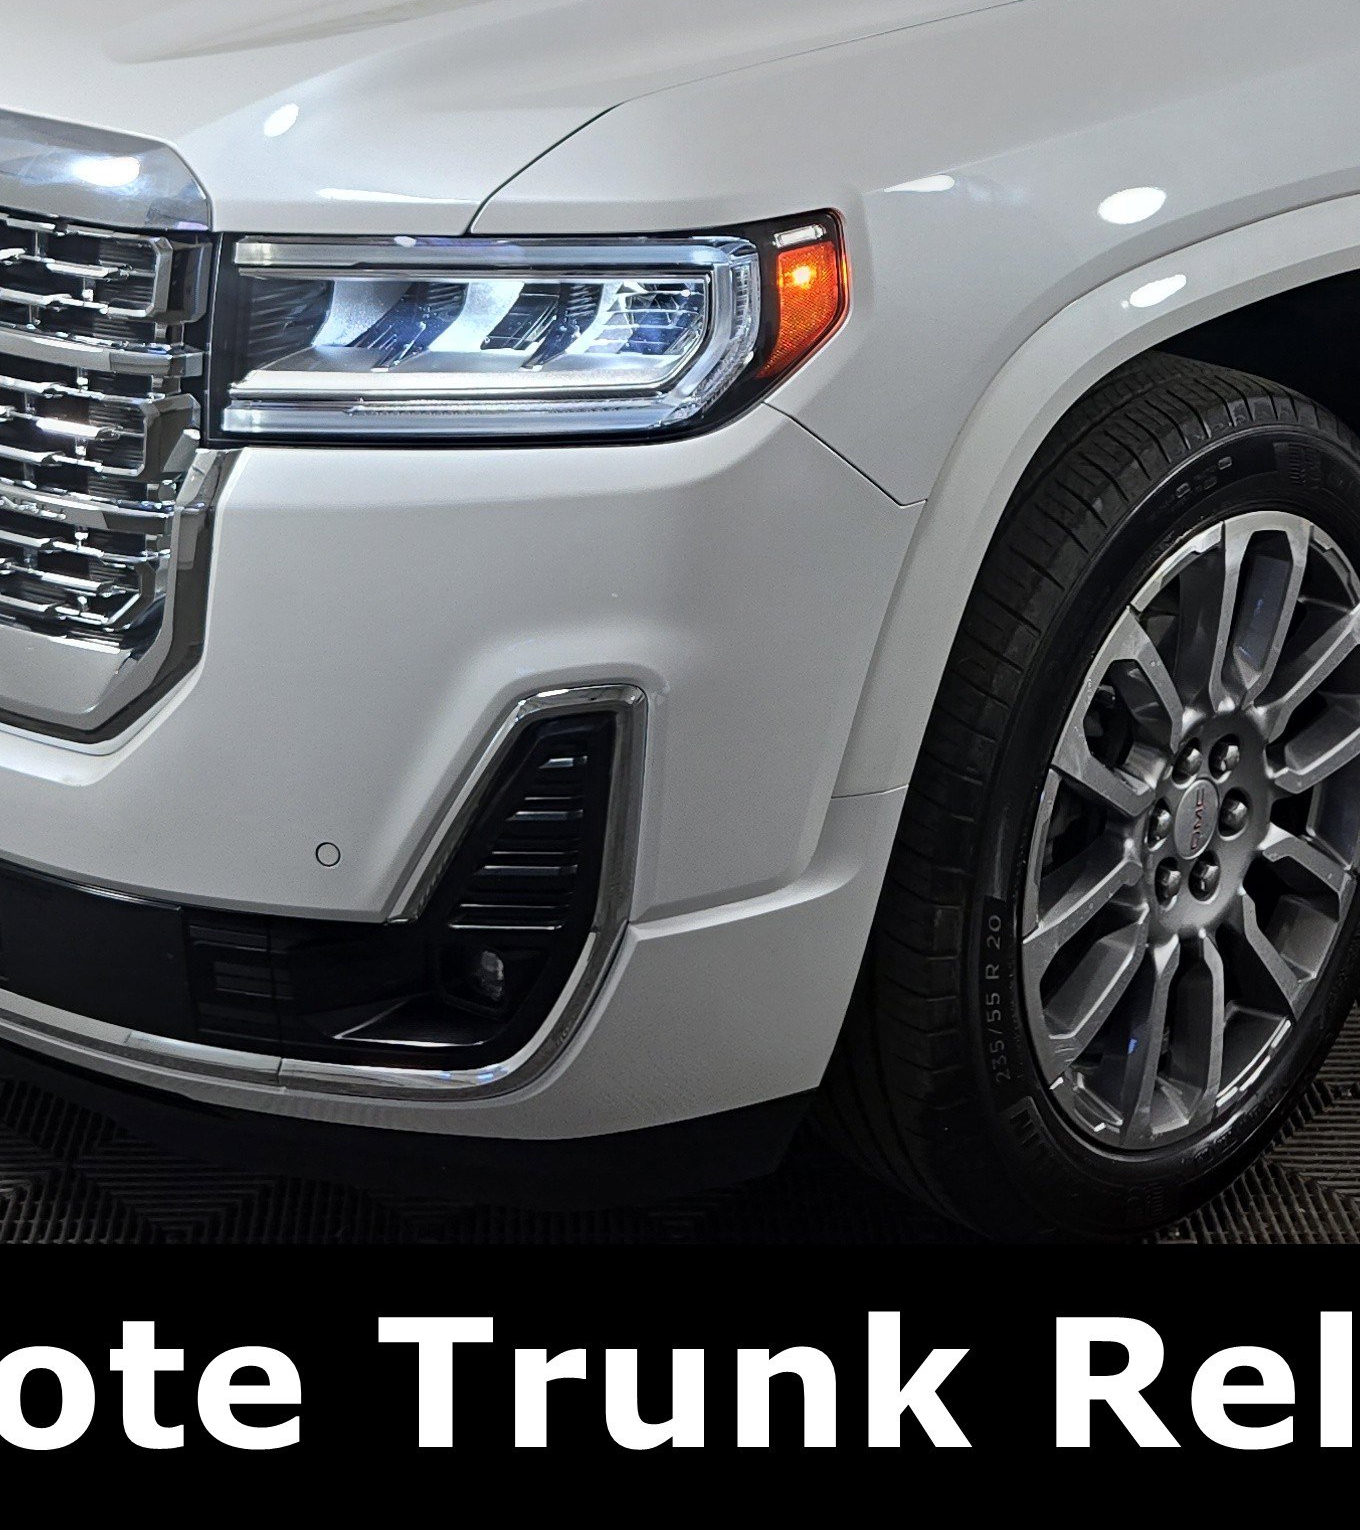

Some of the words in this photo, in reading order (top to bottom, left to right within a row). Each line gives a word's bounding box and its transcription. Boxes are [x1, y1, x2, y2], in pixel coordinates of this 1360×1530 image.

[985, 914, 1002, 950] 20
[985, 962, 1001, 982] R
[985, 991, 1012, 1084] 235/55
